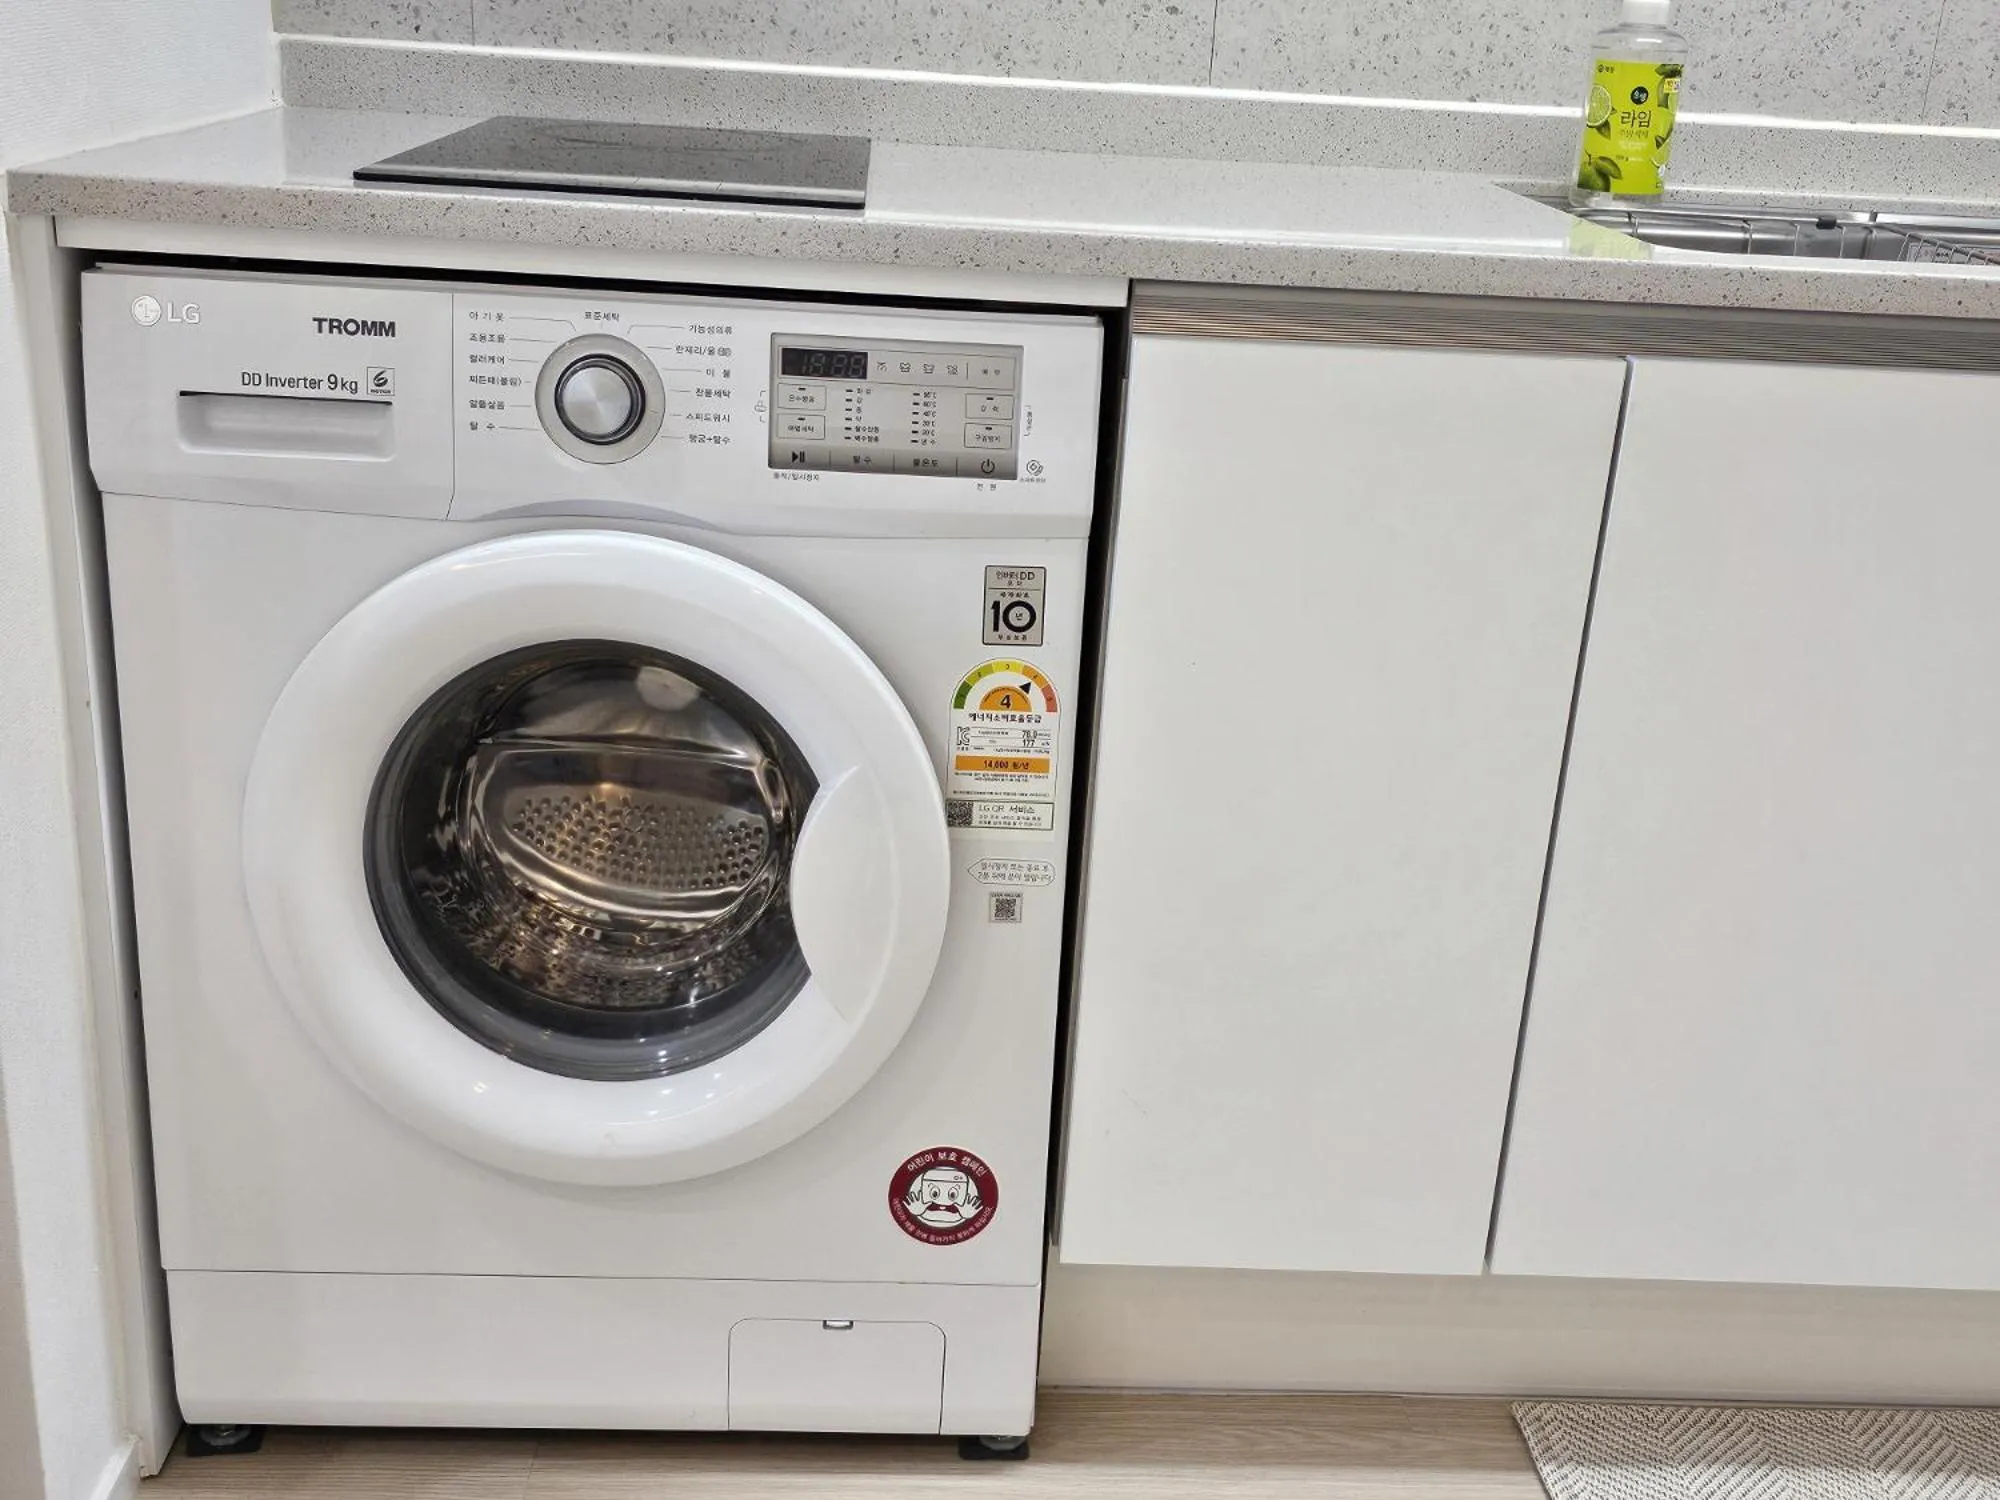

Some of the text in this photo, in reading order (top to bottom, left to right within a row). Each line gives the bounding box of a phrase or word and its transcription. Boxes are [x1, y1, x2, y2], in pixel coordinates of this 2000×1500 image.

[1620, 110, 1652, 128] 라임
[167, 302, 201, 324] LG
[584, 311, 620, 322] 표준세탁
[313, 317, 396, 338] TROMM
[241, 371, 263, 387] DD
[265, 372, 323, 391] Inverter
[686, 411, 730, 423] 스피드워시
[991, 600, 1037, 633] 10
[1000, 694, 1012, 709] 4
[968, 712, 1042, 724] 에너지소비효율등급
[1009, 805, 1036, 814] 서비스
[907, 1151, 988, 1177] 어린이 보호 캠페인
